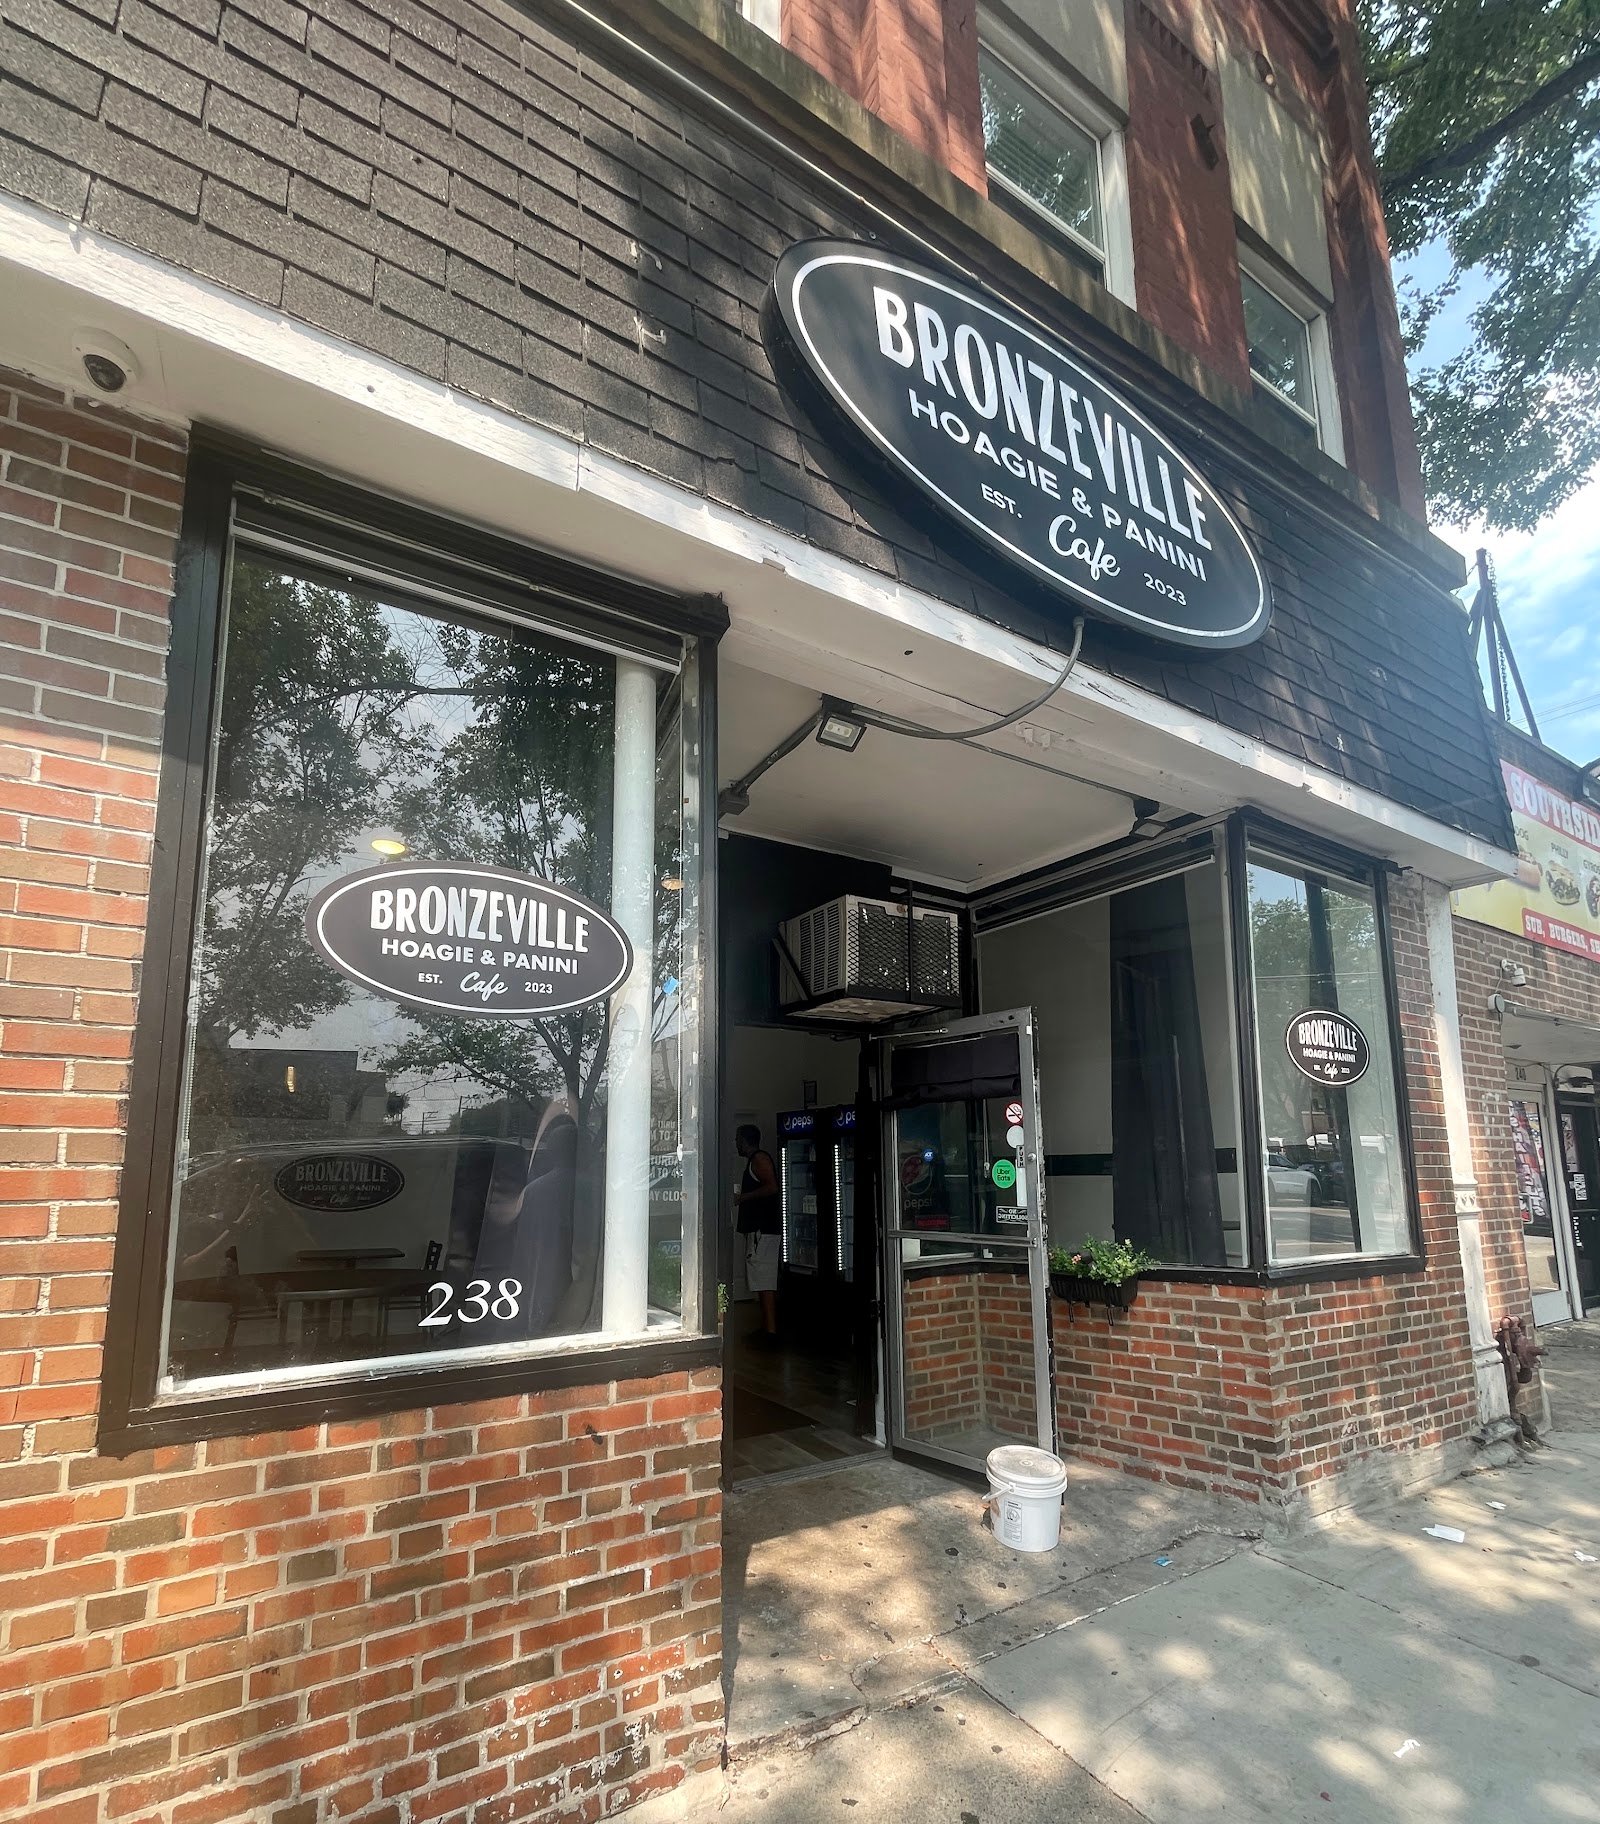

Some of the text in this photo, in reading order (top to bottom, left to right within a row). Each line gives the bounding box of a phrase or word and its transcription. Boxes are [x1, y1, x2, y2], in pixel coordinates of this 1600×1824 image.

[874, 286, 1213, 551] BRONZEVILLE
[910, 389, 1207, 583] HOAGIE & PANINI
[980, 483, 1023, 519] EST.
[1049, 514, 1121, 580] Cafe
[1143, 573, 1188, 606] 2023
[370, 885, 589, 953] BRONZEVILLE
[381, 937, 579, 975] HOAGIE & PANINI
[418, 971, 553, 1002] EST. Cafe 2023
[1298, 1019, 1358, 1051] BRONZEVILLE
[1302, 1047, 1328, 1060] HOAGIE
[1334, 1051, 1356, 1063] PANINI
[296, 1160, 388, 1183] BRONZEVILLE
[418, 1278, 522, 1327] 238
